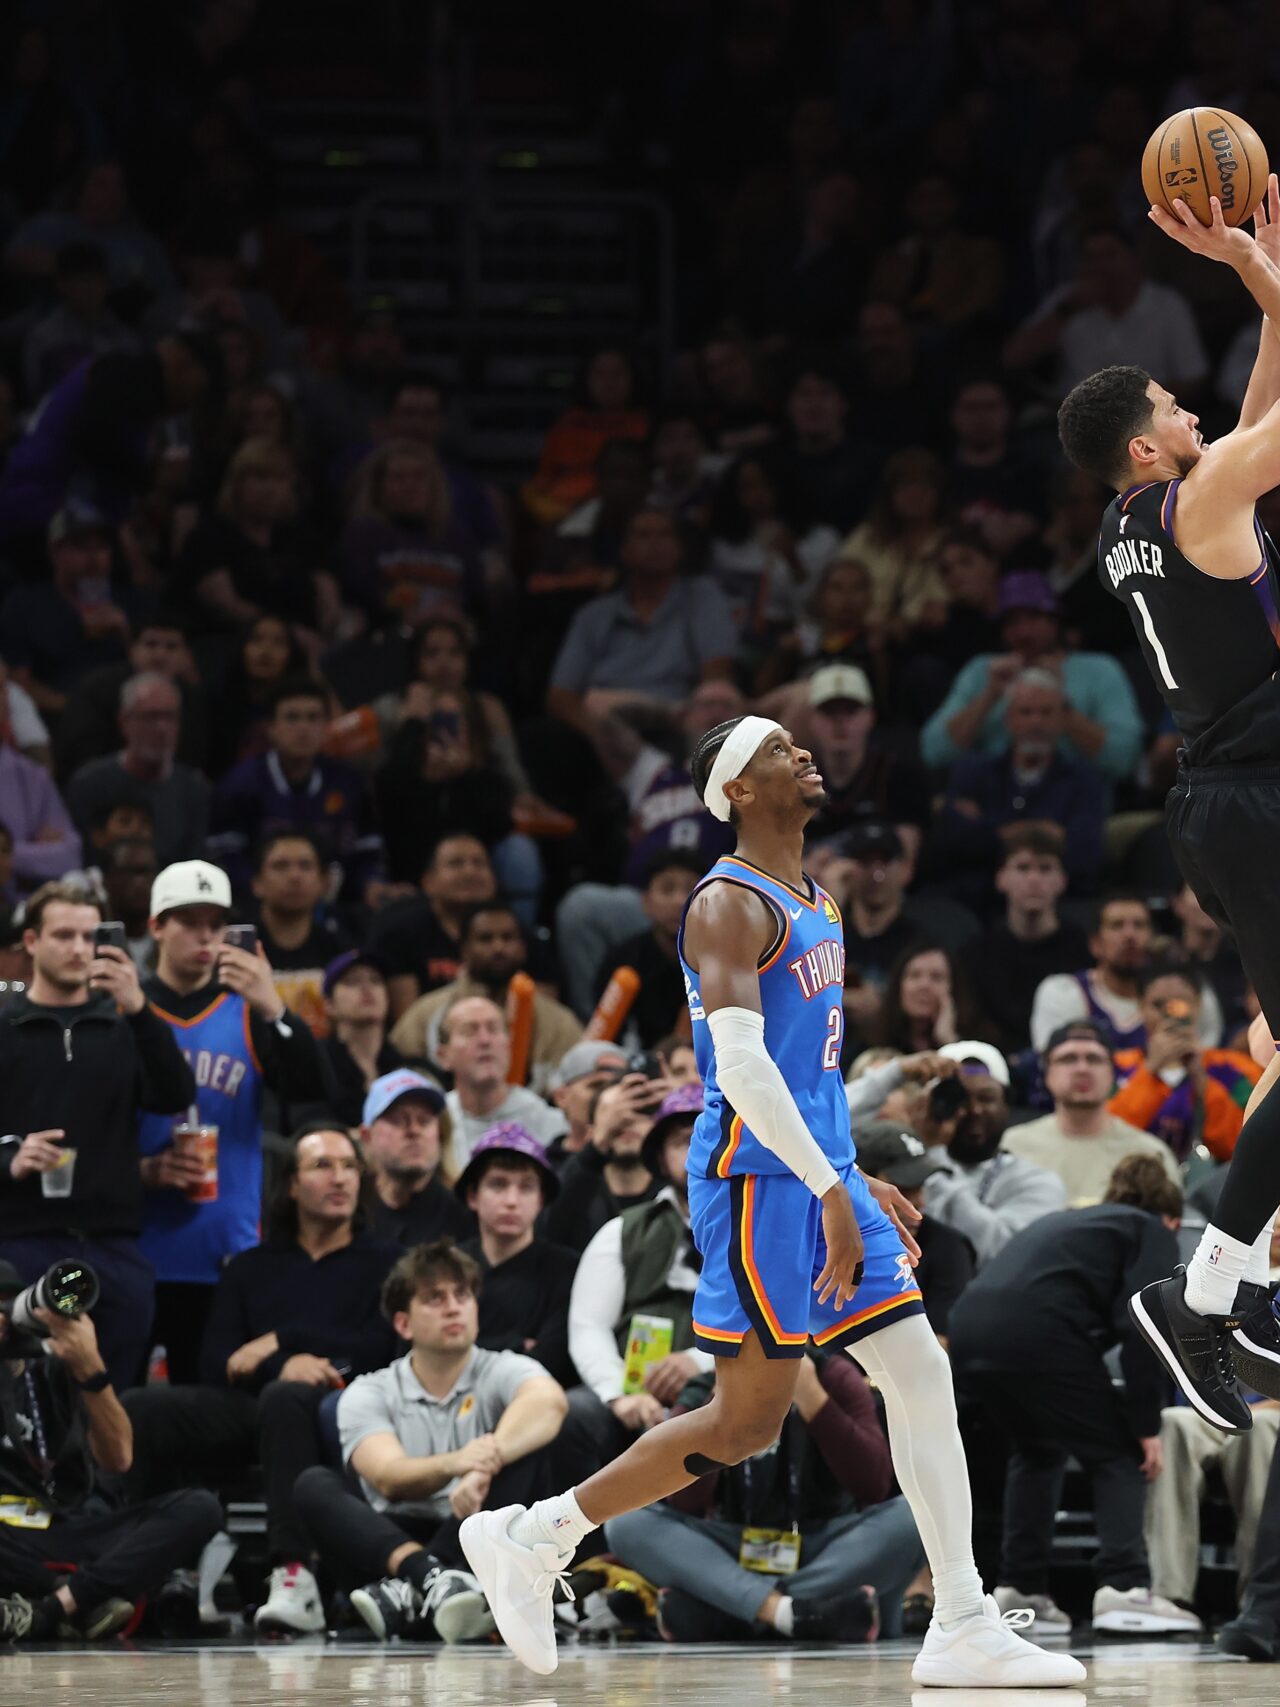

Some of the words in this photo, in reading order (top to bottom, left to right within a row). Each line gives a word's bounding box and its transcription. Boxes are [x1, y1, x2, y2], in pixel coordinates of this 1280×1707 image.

[1207, 128, 1238, 210] Wilson
[1105, 538, 1166, 590] BOOKER
[1131, 590, 1180, 690] 1
[789, 939, 846, 1001] THUND
[822, 1005, 843, 1072] 2
[184, 1048, 248, 1098] DER
